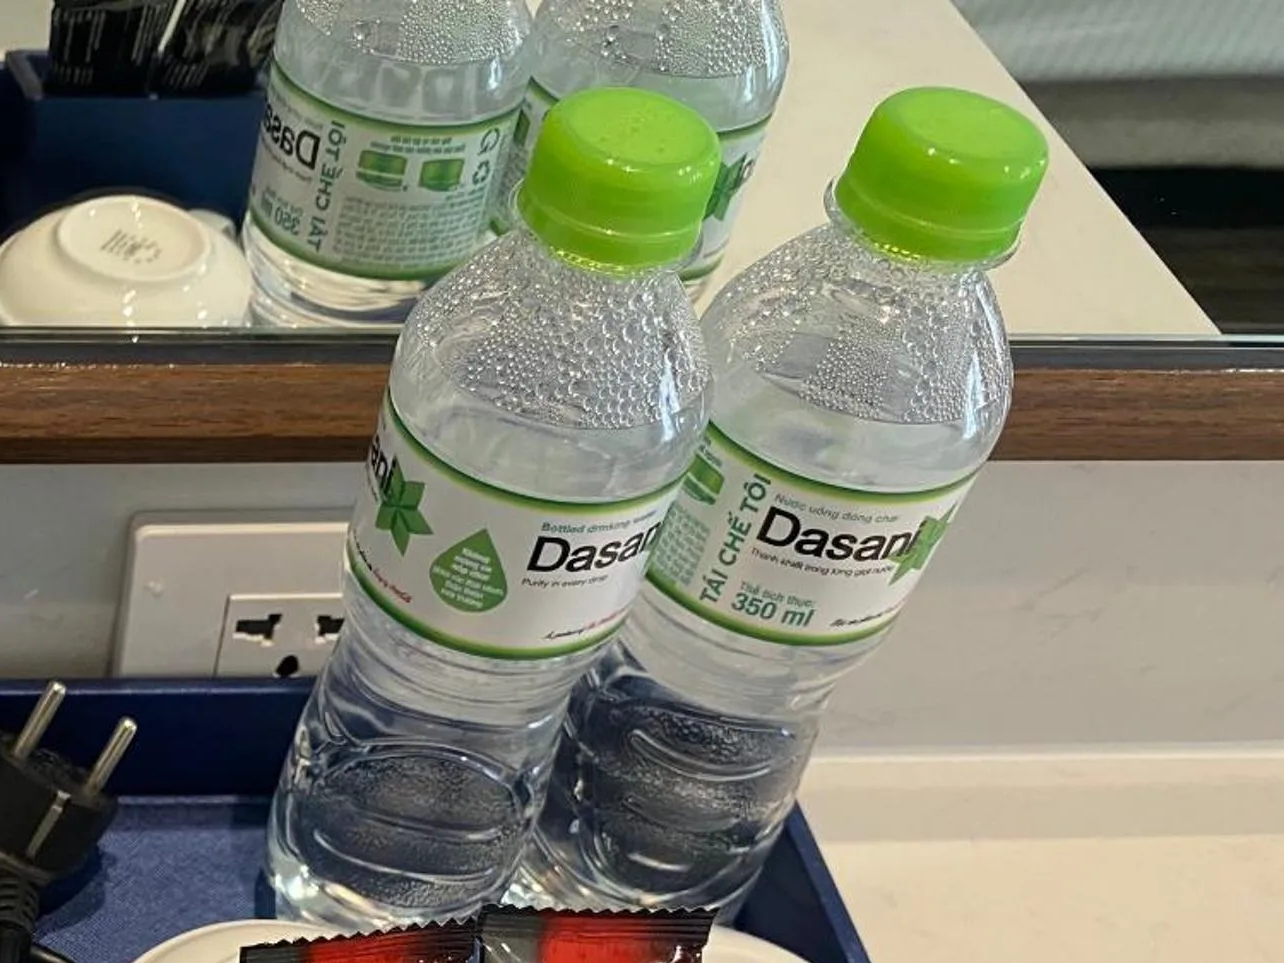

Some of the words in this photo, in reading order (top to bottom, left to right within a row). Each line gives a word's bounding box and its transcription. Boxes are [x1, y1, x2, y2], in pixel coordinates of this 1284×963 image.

[527, 521, 663, 572] Dasan
[541, 522, 585, 533] Bottled
[700, 568, 728, 602] TÁI
[719, 511, 752, 566] CHẾ
[740, 473, 771, 513] TỐI
[731, 592, 776, 620] 350
[781, 608, 815, 627] ml
